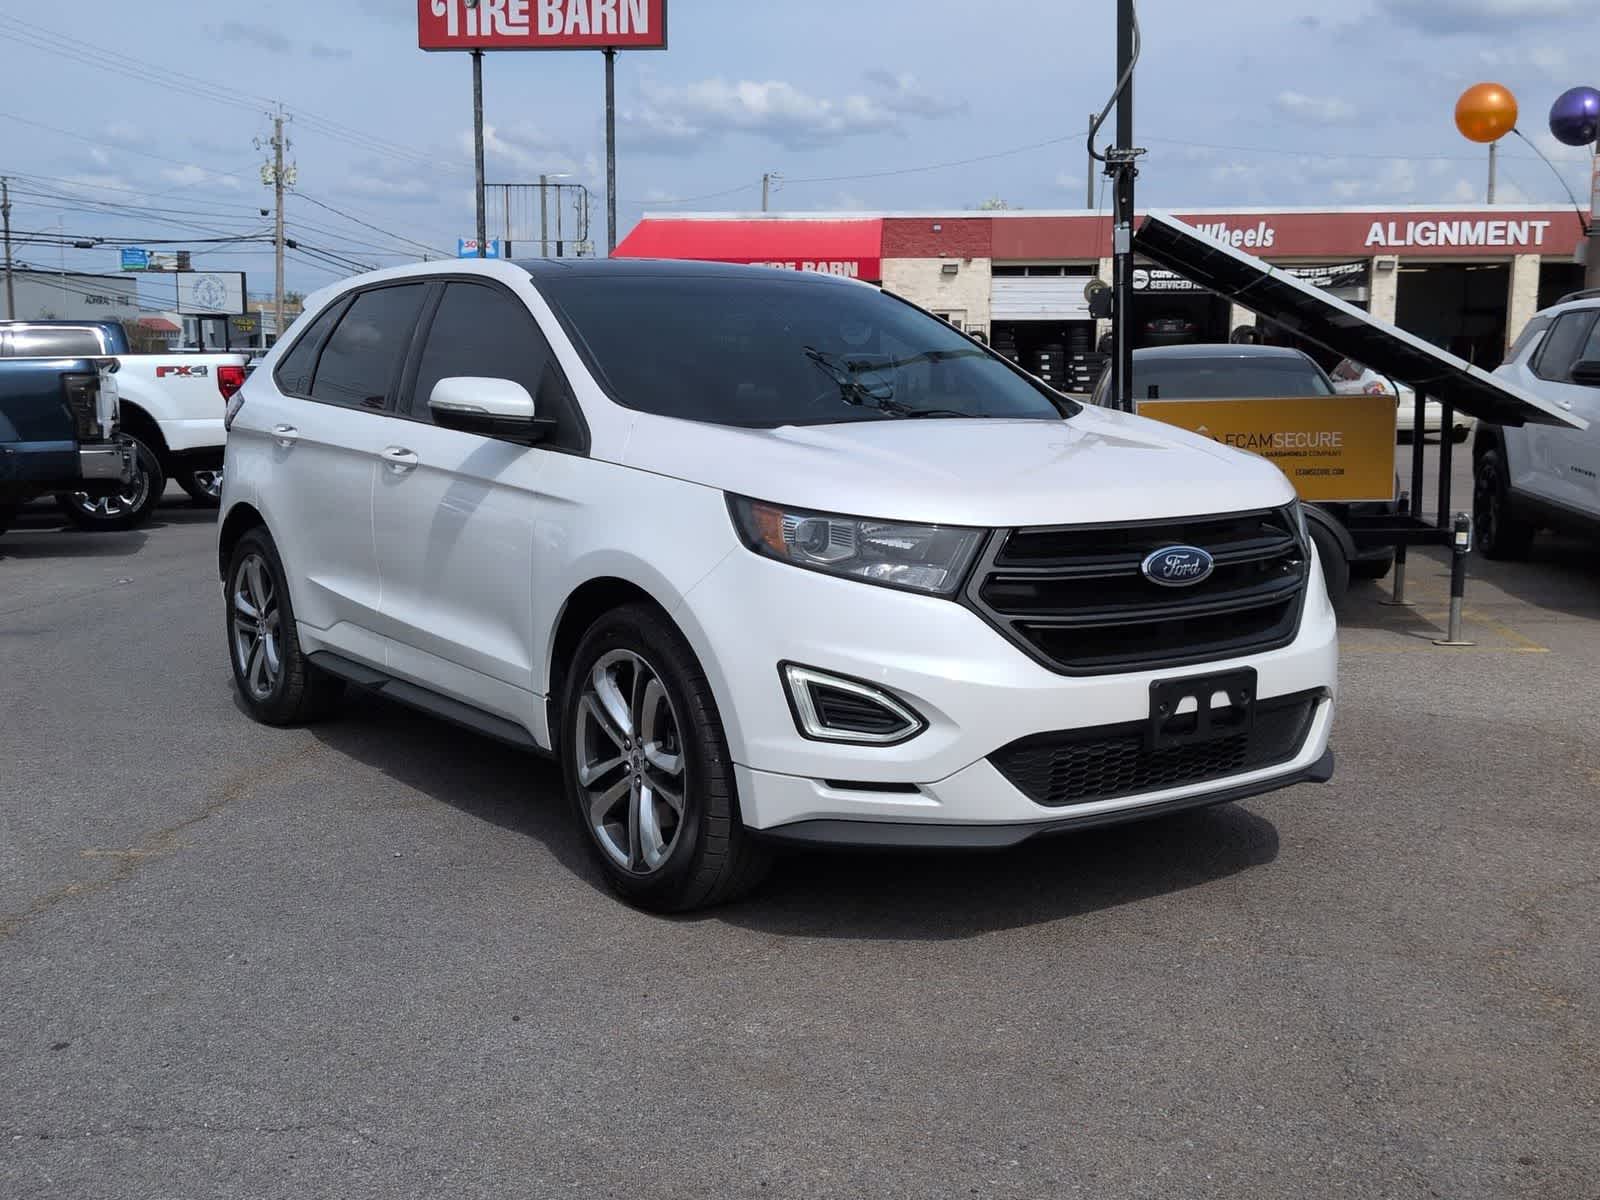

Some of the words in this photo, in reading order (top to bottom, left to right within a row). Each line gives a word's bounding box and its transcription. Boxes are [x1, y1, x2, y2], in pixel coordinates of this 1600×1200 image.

[431, 0, 529, 36] TIRE
[537, 0, 649, 36] BARN
[1365, 221, 1550, 246] ALIGNMENT
[464, 240, 491, 249] SOC
[749, 261, 797, 271] IRE
[801, 261, 858, 277] BARN
[156, 365, 208, 378] FX4
[1225, 431, 1344, 448] ECAMSECURE
[1162, 554, 1201, 578] Ford
